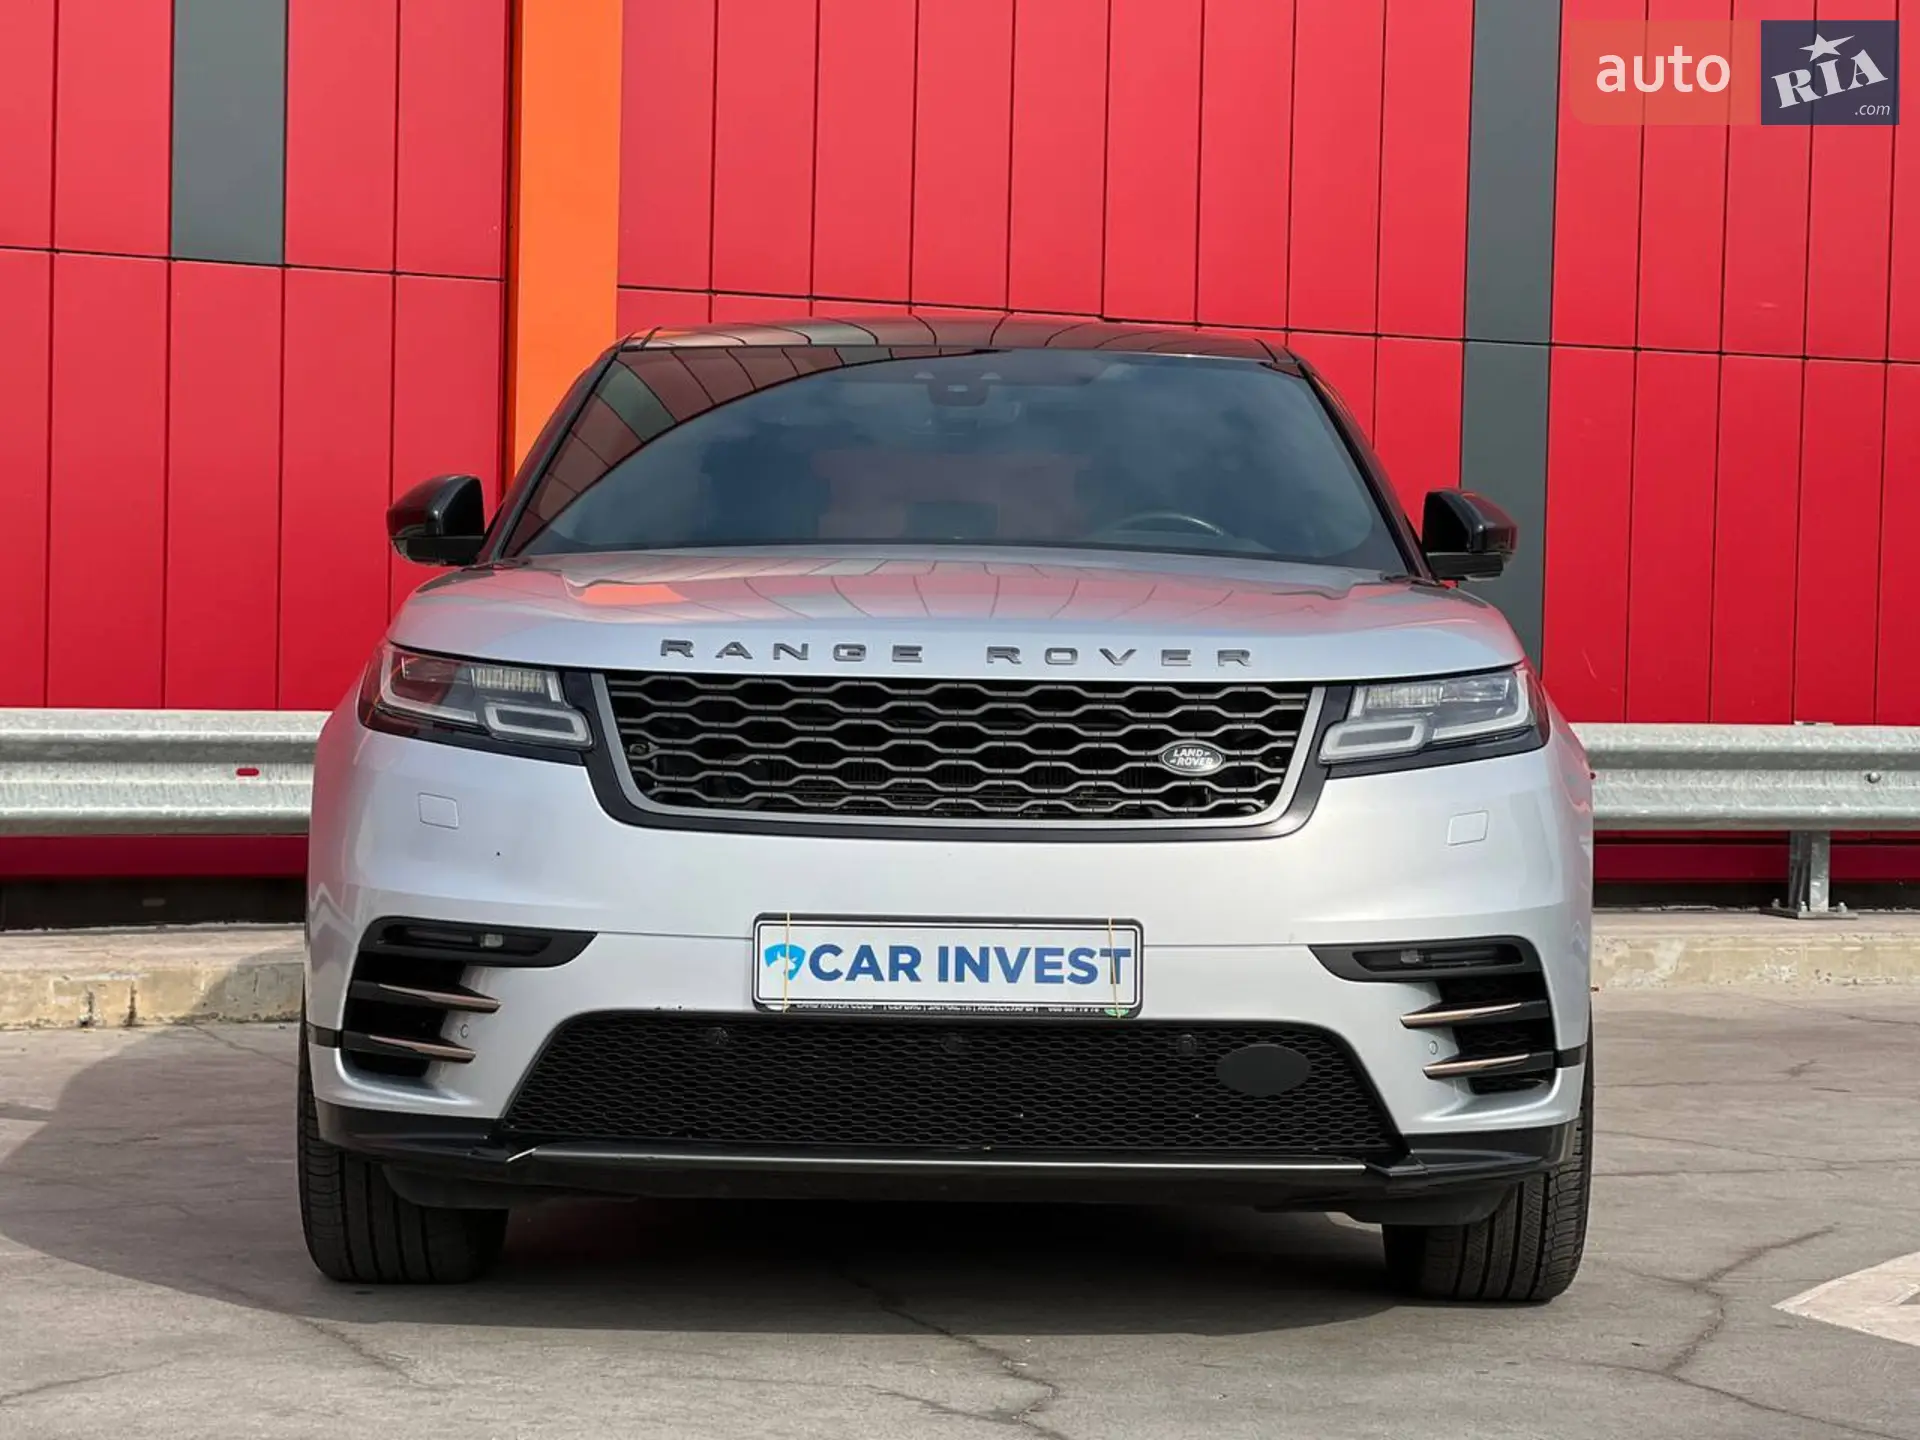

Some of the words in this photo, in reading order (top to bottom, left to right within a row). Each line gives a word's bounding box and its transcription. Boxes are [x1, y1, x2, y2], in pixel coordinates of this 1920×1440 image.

[660, 639, 923, 663] RANGE
[986, 645, 1251, 667] ROVER
[1173, 748, 1204, 757] LAND
[1176, 757, 1214, 766] ROVER
[808, 943, 922, 982] CAR
[938, 946, 1131, 985] INVEST
